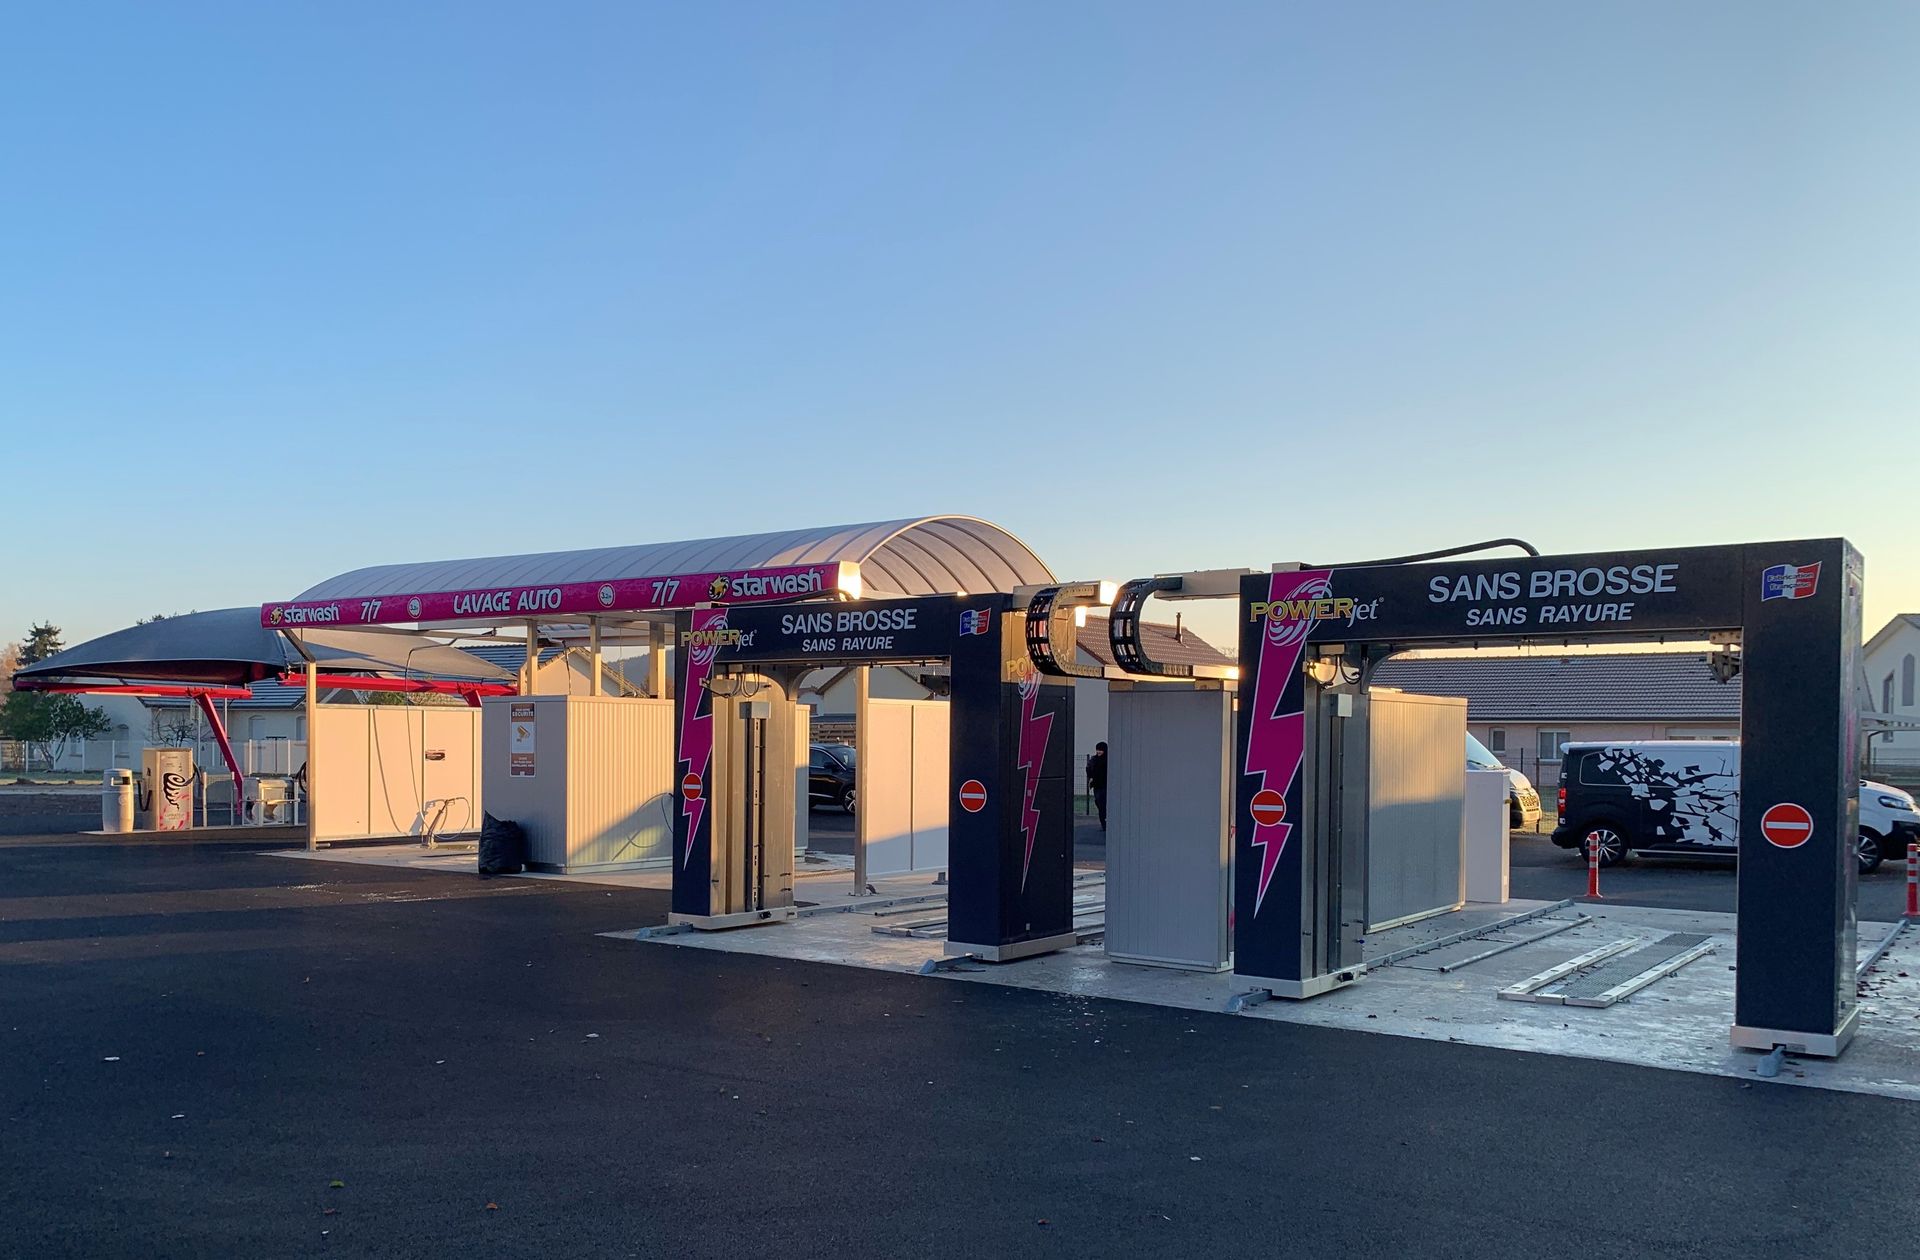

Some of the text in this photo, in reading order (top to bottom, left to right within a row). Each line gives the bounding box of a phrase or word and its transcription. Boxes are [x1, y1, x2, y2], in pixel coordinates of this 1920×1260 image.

[651, 578, 680, 606] 7/7
[732, 567, 823, 597] starwash
[1428, 564, 1679, 603] SANS BROSSE
[284, 603, 340, 623] starwash
[360, 599, 382, 623] 7/7
[453, 587, 562, 614] LAVAGE AUTO
[1465, 602, 1635, 626] SANS RAYURE
[781, 608, 918, 635] SANS BROSSE
[802, 636, 895, 652] SANS RAYURE
